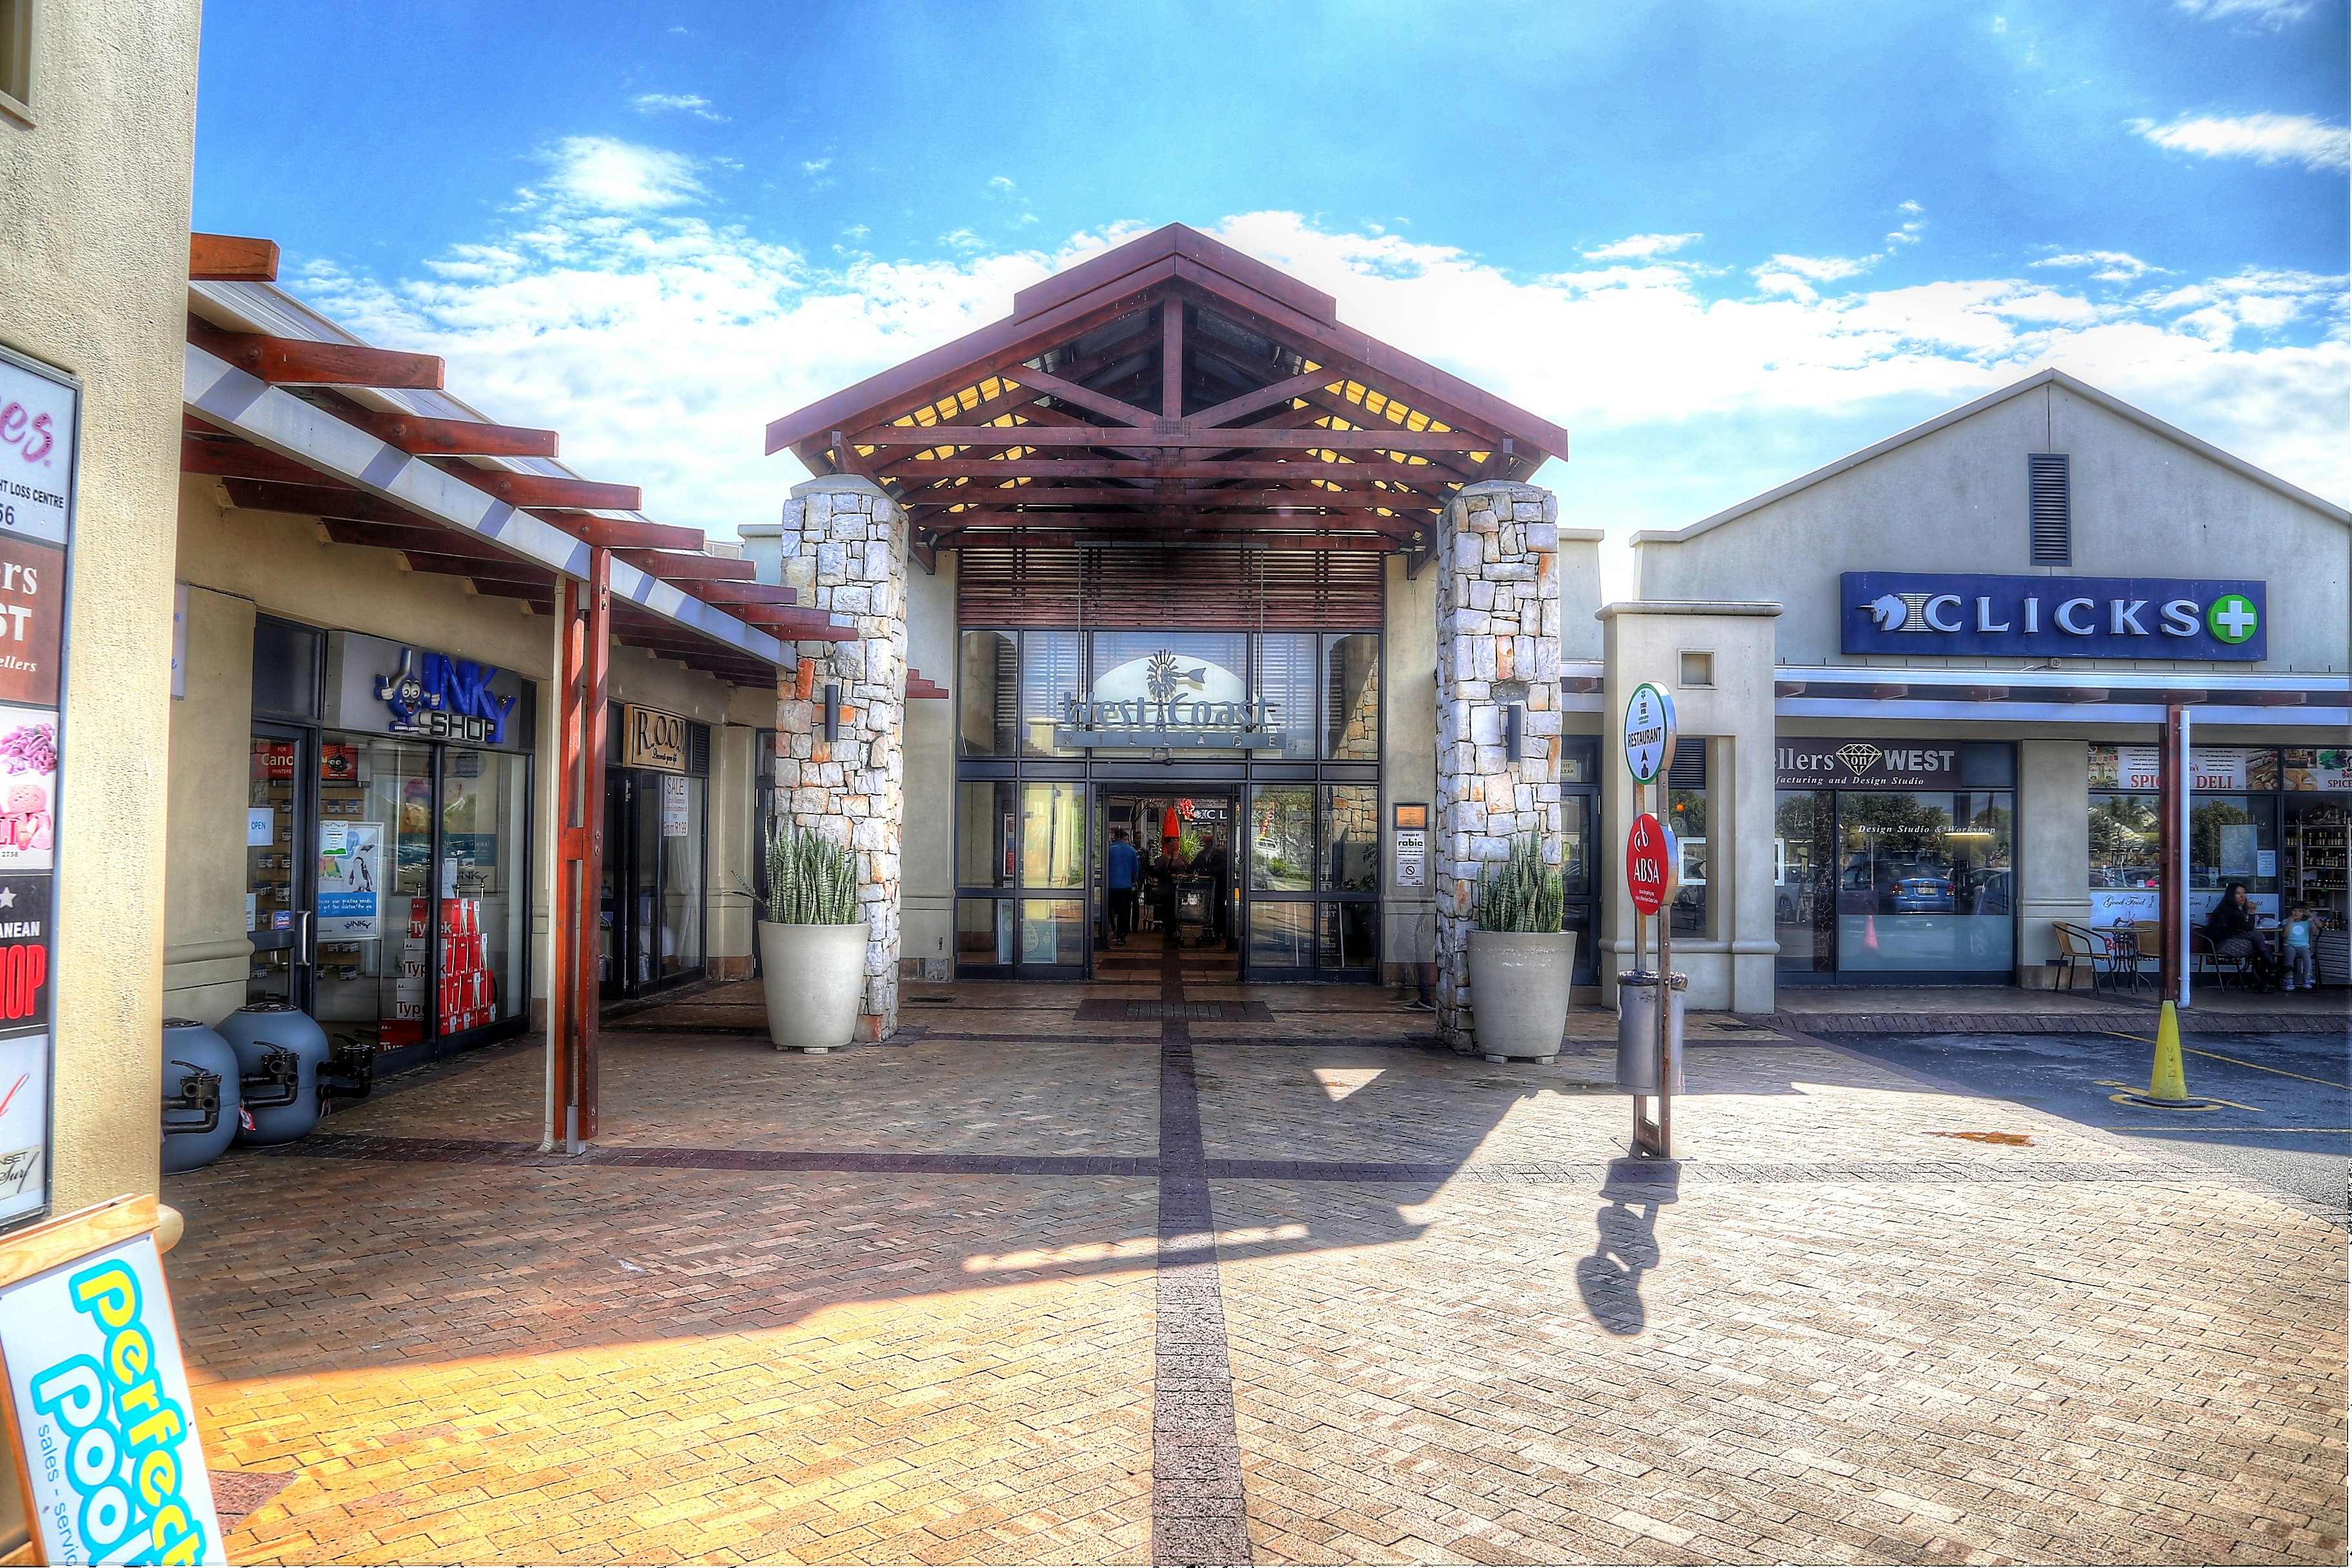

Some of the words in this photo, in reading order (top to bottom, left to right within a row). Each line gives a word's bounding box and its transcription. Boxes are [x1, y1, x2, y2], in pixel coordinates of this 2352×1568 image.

[11, 482, 30, 499] LOSS
[33, 489, 64, 509] CENTRE
[0, 562, 37, 595] rs
[1926, 594, 2200, 637] CLICKS
[422, 653, 516, 743] INKY
[1064, 692, 1151, 726] West
[1168, 692, 1269, 727] Coast
[419, 712, 496, 741] SHOP
[1628, 727, 1661, 748] RESTAURANT
[1064, 732, 1277, 747] VILLAGE
[1774, 748, 1834, 770] llers
[1851, 756, 1867, 765] on
[1884, 750, 1955, 771] WEST
[667, 777, 684, 795] SALE
[1852, 776, 1886, 785] Design
[1892, 776, 1924, 785] Studio
[2196, 775, 2233, 789] DELI
[251, 821, 266, 830] OPEN
[675, 821, 687, 834] R199
[1858, 825, 1892, 835] Design
[1897, 825, 1930, 834] Studio
[1947, 826, 1995, 835] Workshop
[1634, 858, 1660, 884] ABSA
[2103, 895, 2126, 908] Good
[2125, 896, 2146, 906] Food
[351, 920, 372, 929] INKY
[72, 1264, 204, 1565] perfect
[39, 1424, 59, 1482] sales
